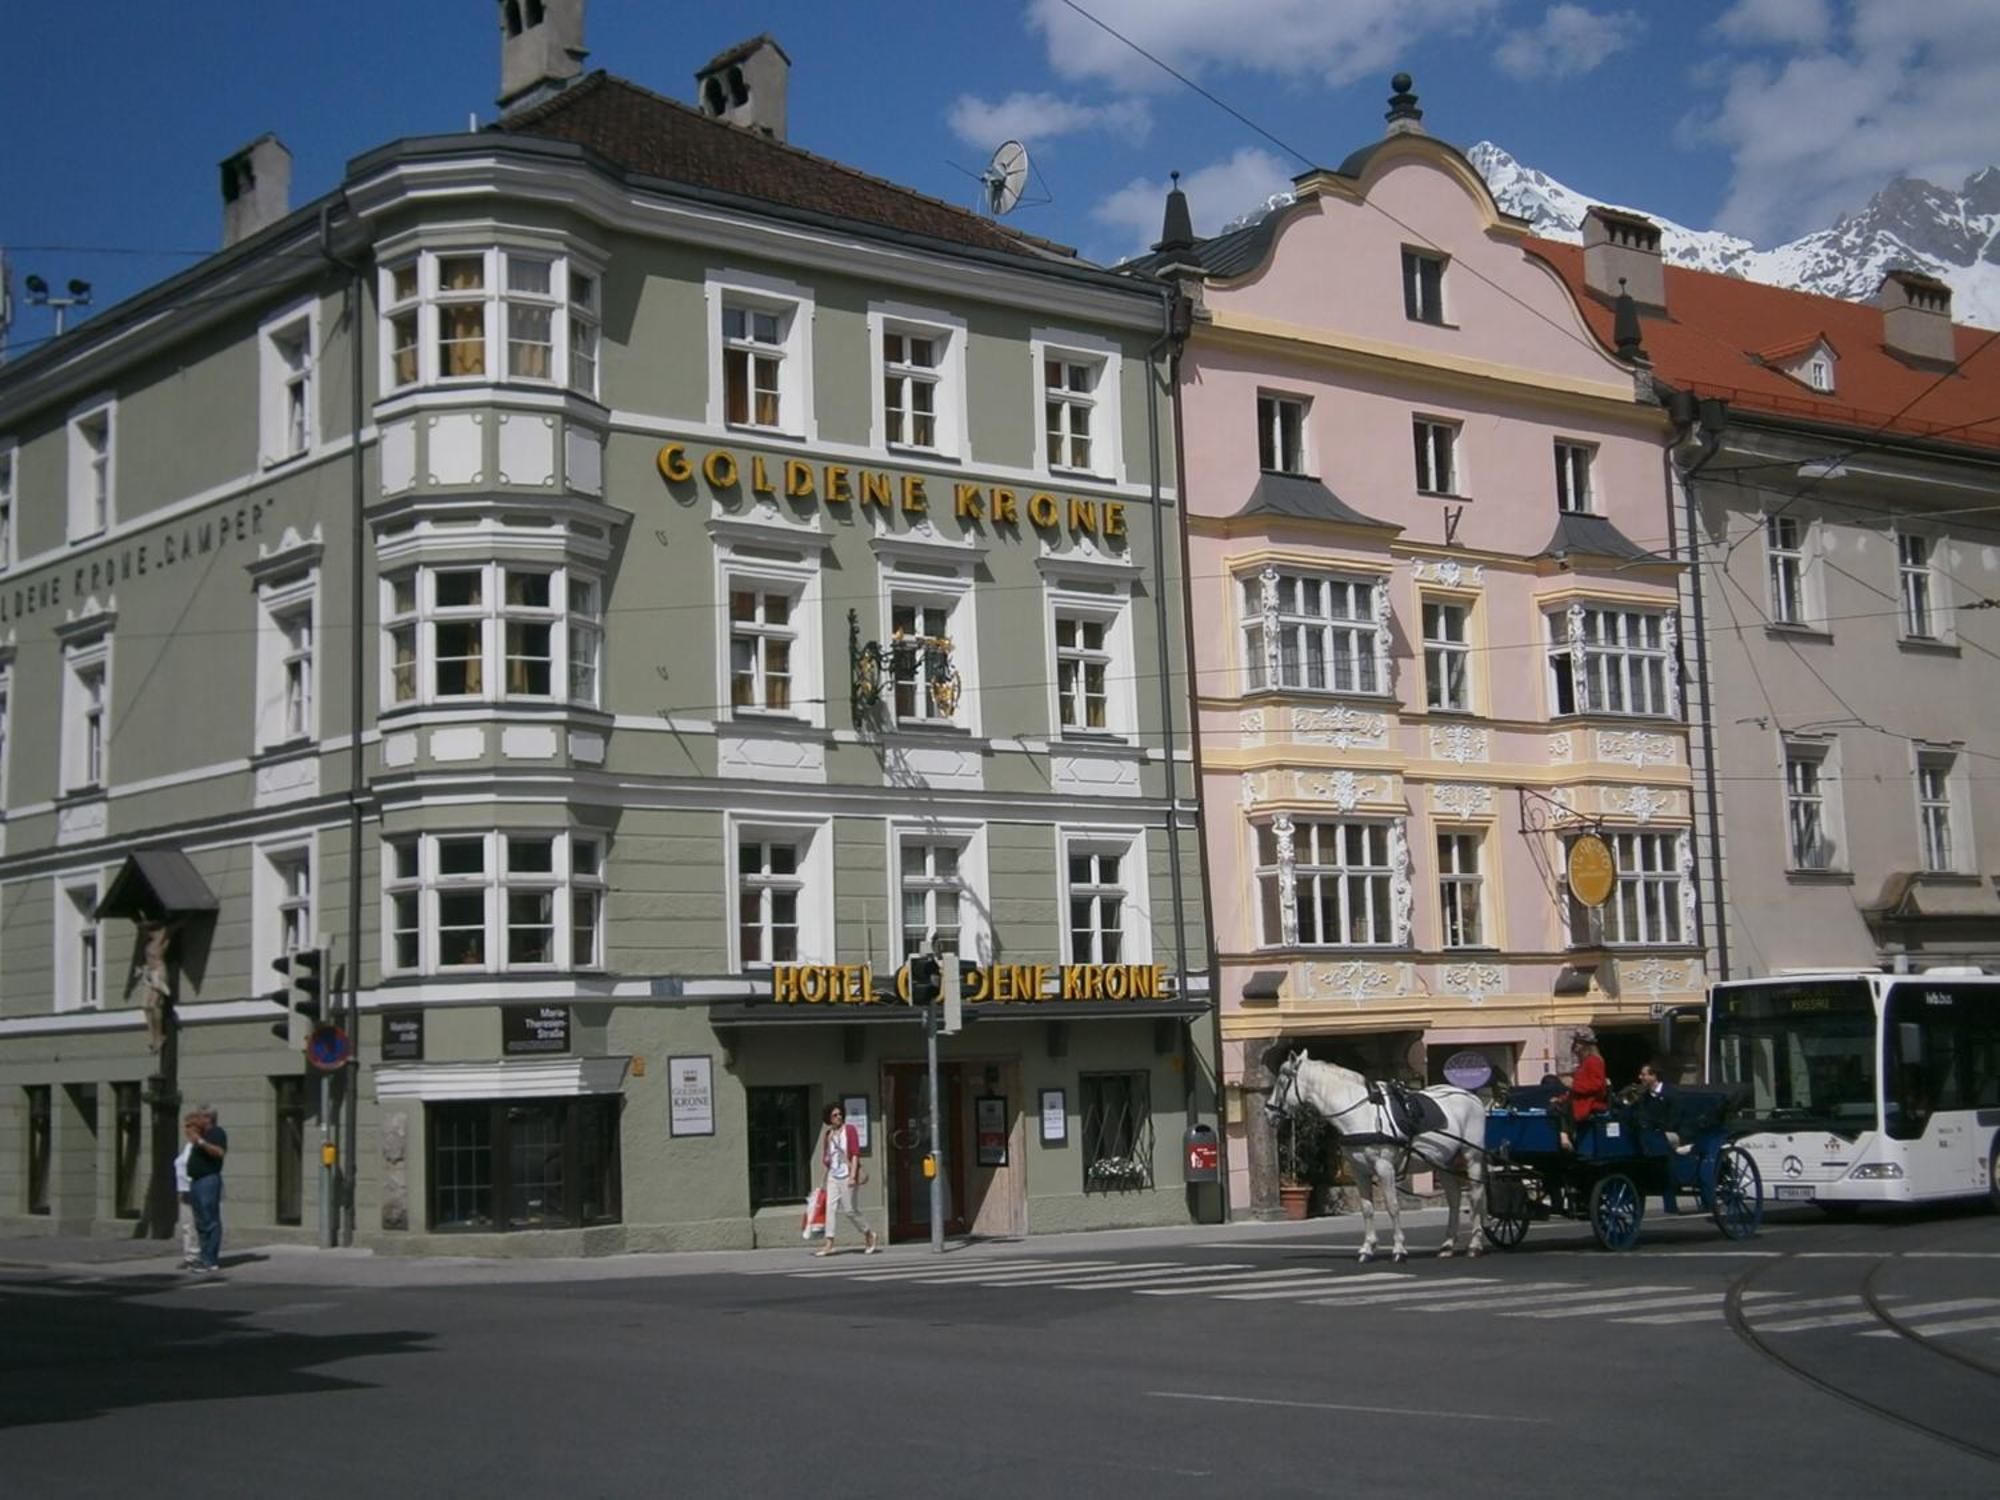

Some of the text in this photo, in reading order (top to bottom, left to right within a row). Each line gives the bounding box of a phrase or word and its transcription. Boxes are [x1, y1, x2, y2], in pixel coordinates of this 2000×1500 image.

[657, 442, 1127, 537] GOLDENE KRONE
[75, 546, 147, 597] KRONE
[774, 963, 880, 1003] HOTEL
[1062, 963, 1169, 1001] KRONE
[674, 1096, 709, 1107] KRONE
